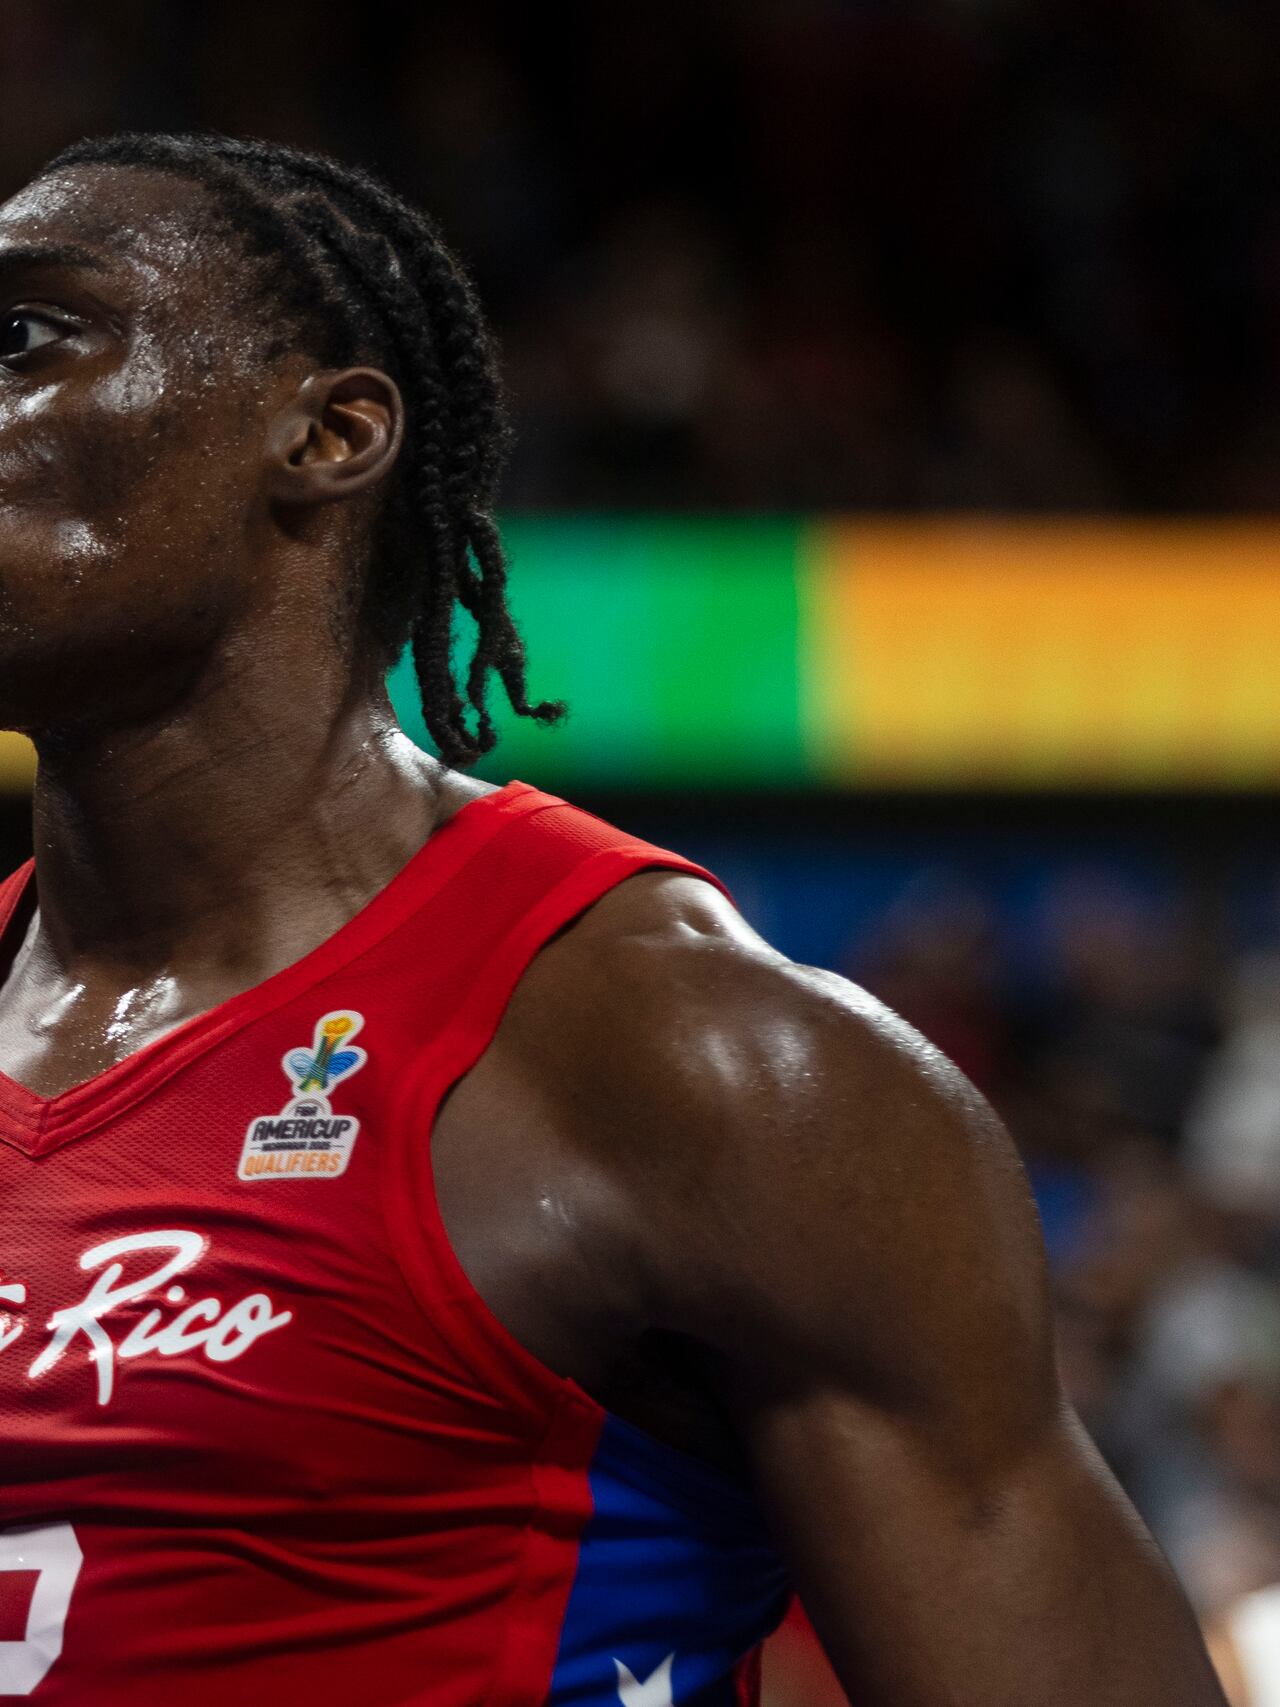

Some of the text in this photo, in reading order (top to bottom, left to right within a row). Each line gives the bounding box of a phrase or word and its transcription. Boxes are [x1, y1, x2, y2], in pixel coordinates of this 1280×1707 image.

[253, 1119, 351, 1141] AMERICUP
[245, 1153, 341, 1176] QUALIFIERS
[29, 1230, 292, 1405] Rico
